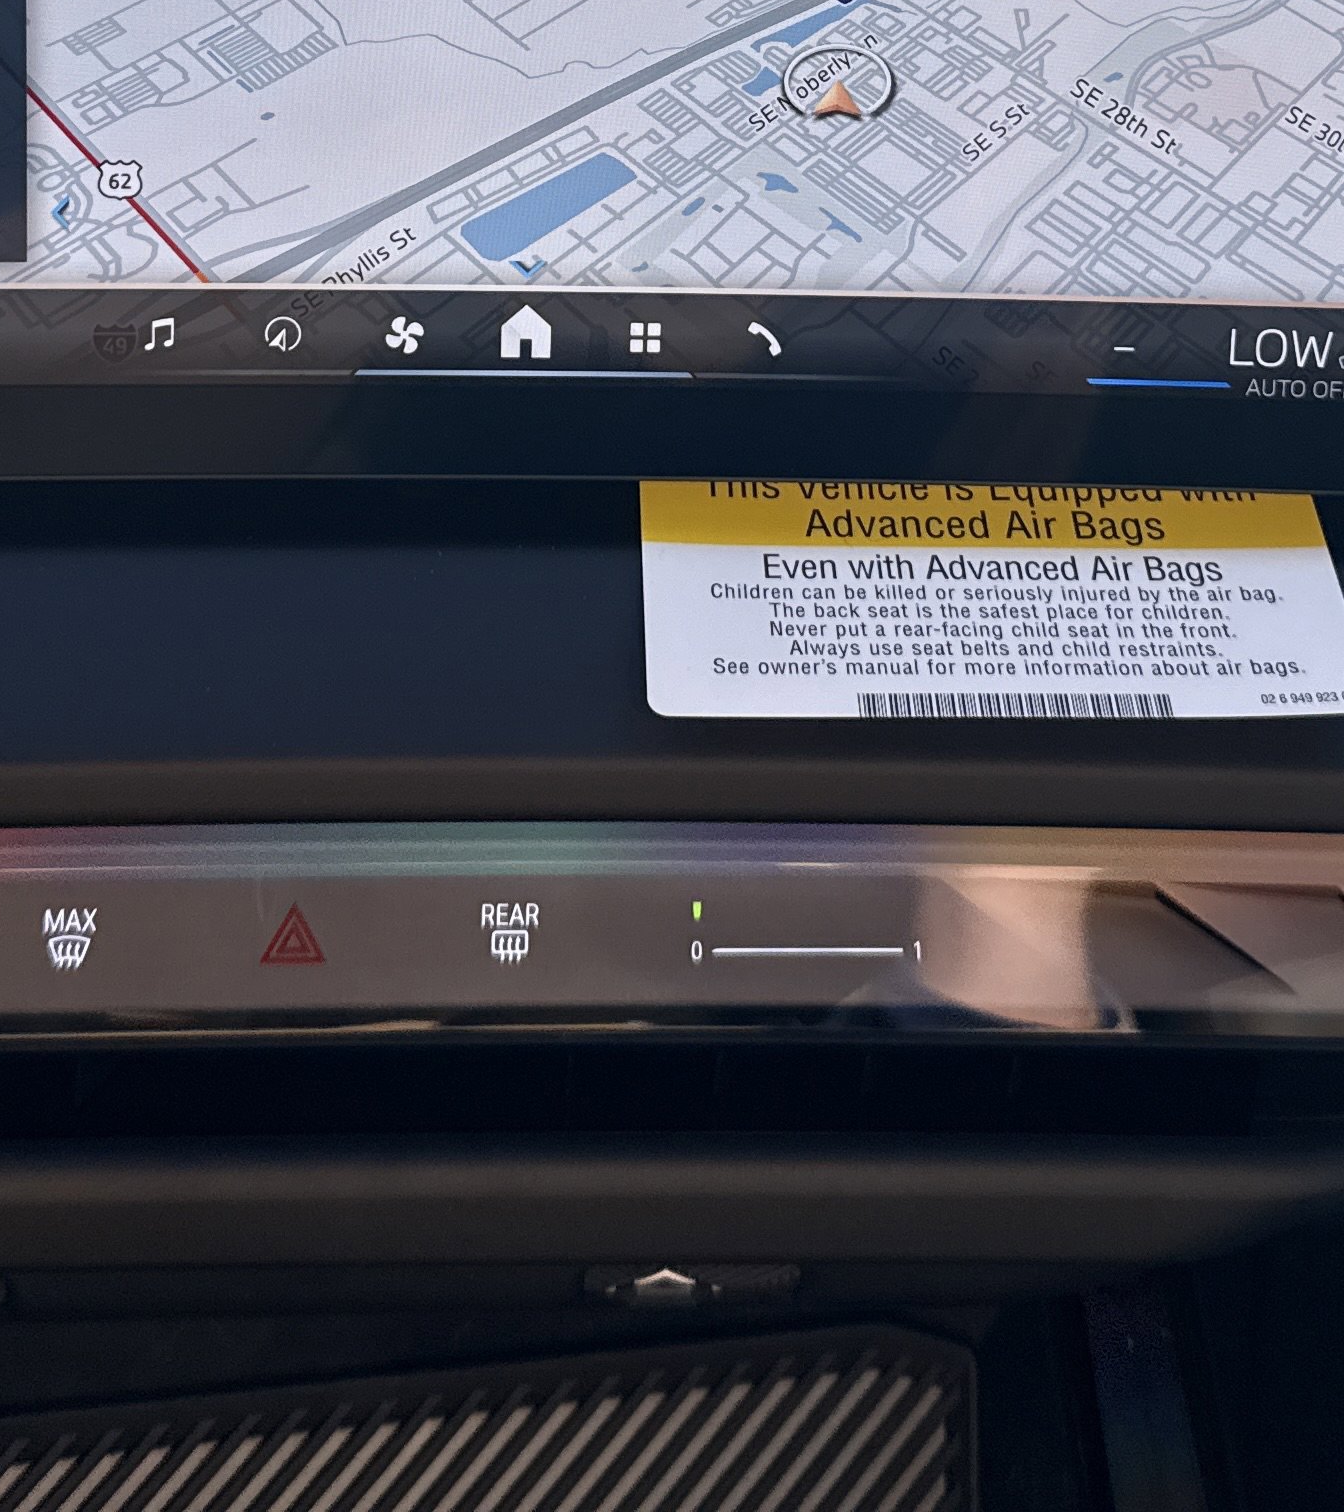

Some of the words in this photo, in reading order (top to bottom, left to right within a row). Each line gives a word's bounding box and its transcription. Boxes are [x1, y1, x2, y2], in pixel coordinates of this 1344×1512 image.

[748, 103, 779, 132] SE
[1069, 78, 1104, 109] SE
[1100, 98, 1148, 138] 28th
[1150, 129, 1177, 155] St
[1284, 106, 1317, 133] SE
[962, 132, 993, 162] SE
[989, 120, 1007, 139] S
[1004, 104, 1030, 126] St
[108, 173, 132, 190] 62
[389, 228, 417, 251] St
[1229, 328, 1334, 368] LOW
[1245, 378, 1306, 398] AUTO
[805, 508, 990, 539] Advanced
[1006, 510, 1057, 539] Air
[1071, 510, 1165, 547] Bags
[763, 553, 838, 580] Even
[847, 553, 915, 580] with
[926, 554, 1080, 581] Advanced
[1091, 555, 1133, 582] Air
[1142, 555, 1223, 587] Bags
[710, 582, 794, 600] Children
[801, 587, 836, 600] can
[843, 584, 867, 600] be
[874, 584, 927, 600] killed
[935, 587, 955, 600] or
[962, 585, 1053, 604] seriously
[1061, 585, 1131, 605] injured
[1137, 586, 1161, 604] by
[1167, 586, 1200, 602] the
[1207, 589, 1232, 602] air
[1239, 586, 1284, 604] bag.
[768, 602, 805, 618] The
[813, 602, 861, 618] back
[867, 603, 909, 619] seat
[916, 604, 933, 619] is
[939, 602, 971, 619] the
[978, 603, 1040, 619] safest
[1046, 603, 1098, 623] place
[1105, 604, 1134, 620] for
[1141, 604, 1231, 620] children.
[769, 620, 827, 637] Never
[835, 622, 868, 640] put
[875, 624, 887, 637] a
[894, 621, 1003, 641] rear-facing
[1011, 621, 1060, 638] child
[1067, 623, 1110, 639] seat
[1116, 624, 1135, 638] in
[1141, 622, 1173, 639] the
[1179, 622, 1238, 638] front.
[789, 639, 861, 659] Always
[869, 643, 904, 656] use
[911, 640, 954, 656] seat
[960, 639, 1010, 656] belts
[1017, 640, 1054, 657] and
[1062, 640, 1111, 657] child
[1118, 641, 1223, 657] restraints.
[713, 657, 750, 675] See
[845, 658, 919, 675] manual
[926, 658, 955, 675] for
[964, 662, 1016, 676] more
[1024, 659, 1144, 676] information
[1151, 659, 1210, 676] about
[1216, 662, 1242, 676] air
[1249, 659, 1307, 678] bags.
[1260, 693, 1276, 704] 02
[1316, 691, 1339, 703] 923
[43, 907, 98, 934] MAX
[481, 902, 540, 928] REAR
